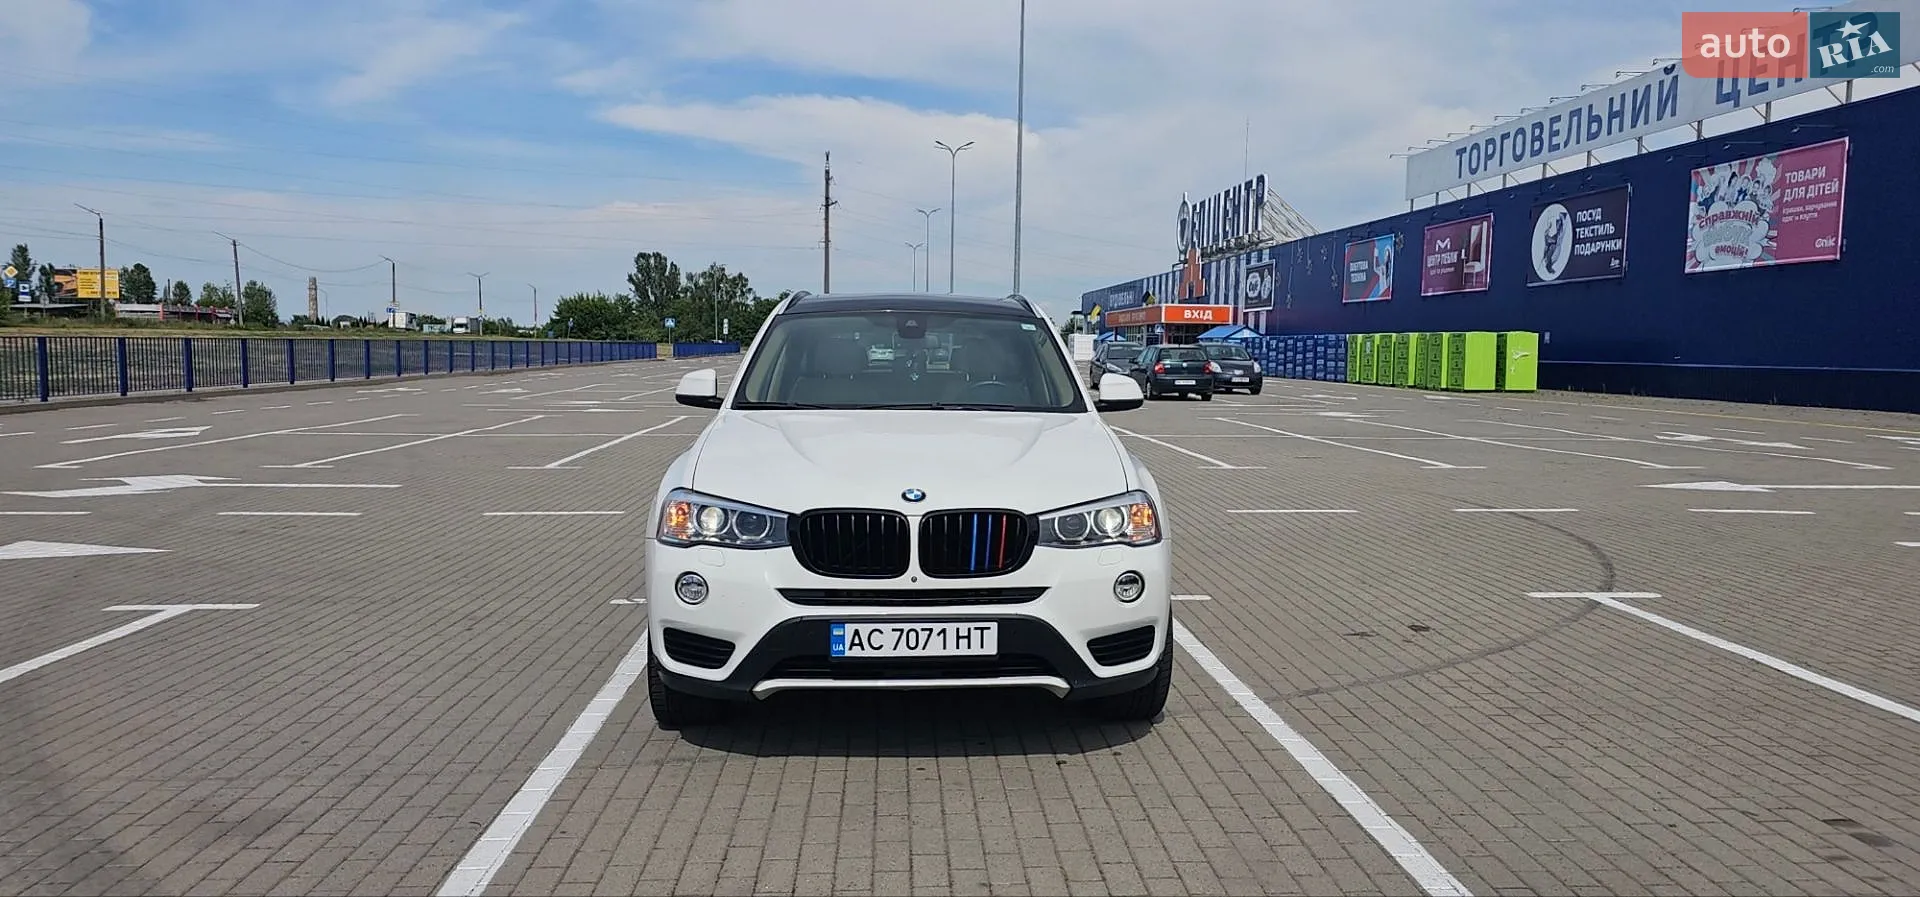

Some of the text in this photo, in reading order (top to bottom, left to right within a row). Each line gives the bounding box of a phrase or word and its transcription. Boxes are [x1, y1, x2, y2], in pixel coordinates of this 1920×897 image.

[1455, 63, 1679, 179] ТОРГОВЕЛЬНИЙ
[1785, 166, 1826, 184] ТОВАРИ
[1783, 178, 1839, 203] ДЛЯ ДІТЕЙ
[1576, 208, 1601, 222] ПОСУД
[1575, 223, 1615, 239] ТЕКСТИЛЬ
[1574, 239, 1622, 256] ПОДАРУНКИ
[1184, 309, 1213, 320] ВХІД
[832, 643, 844, 651] UA
[848, 626, 991, 651] AC 7071 HT
